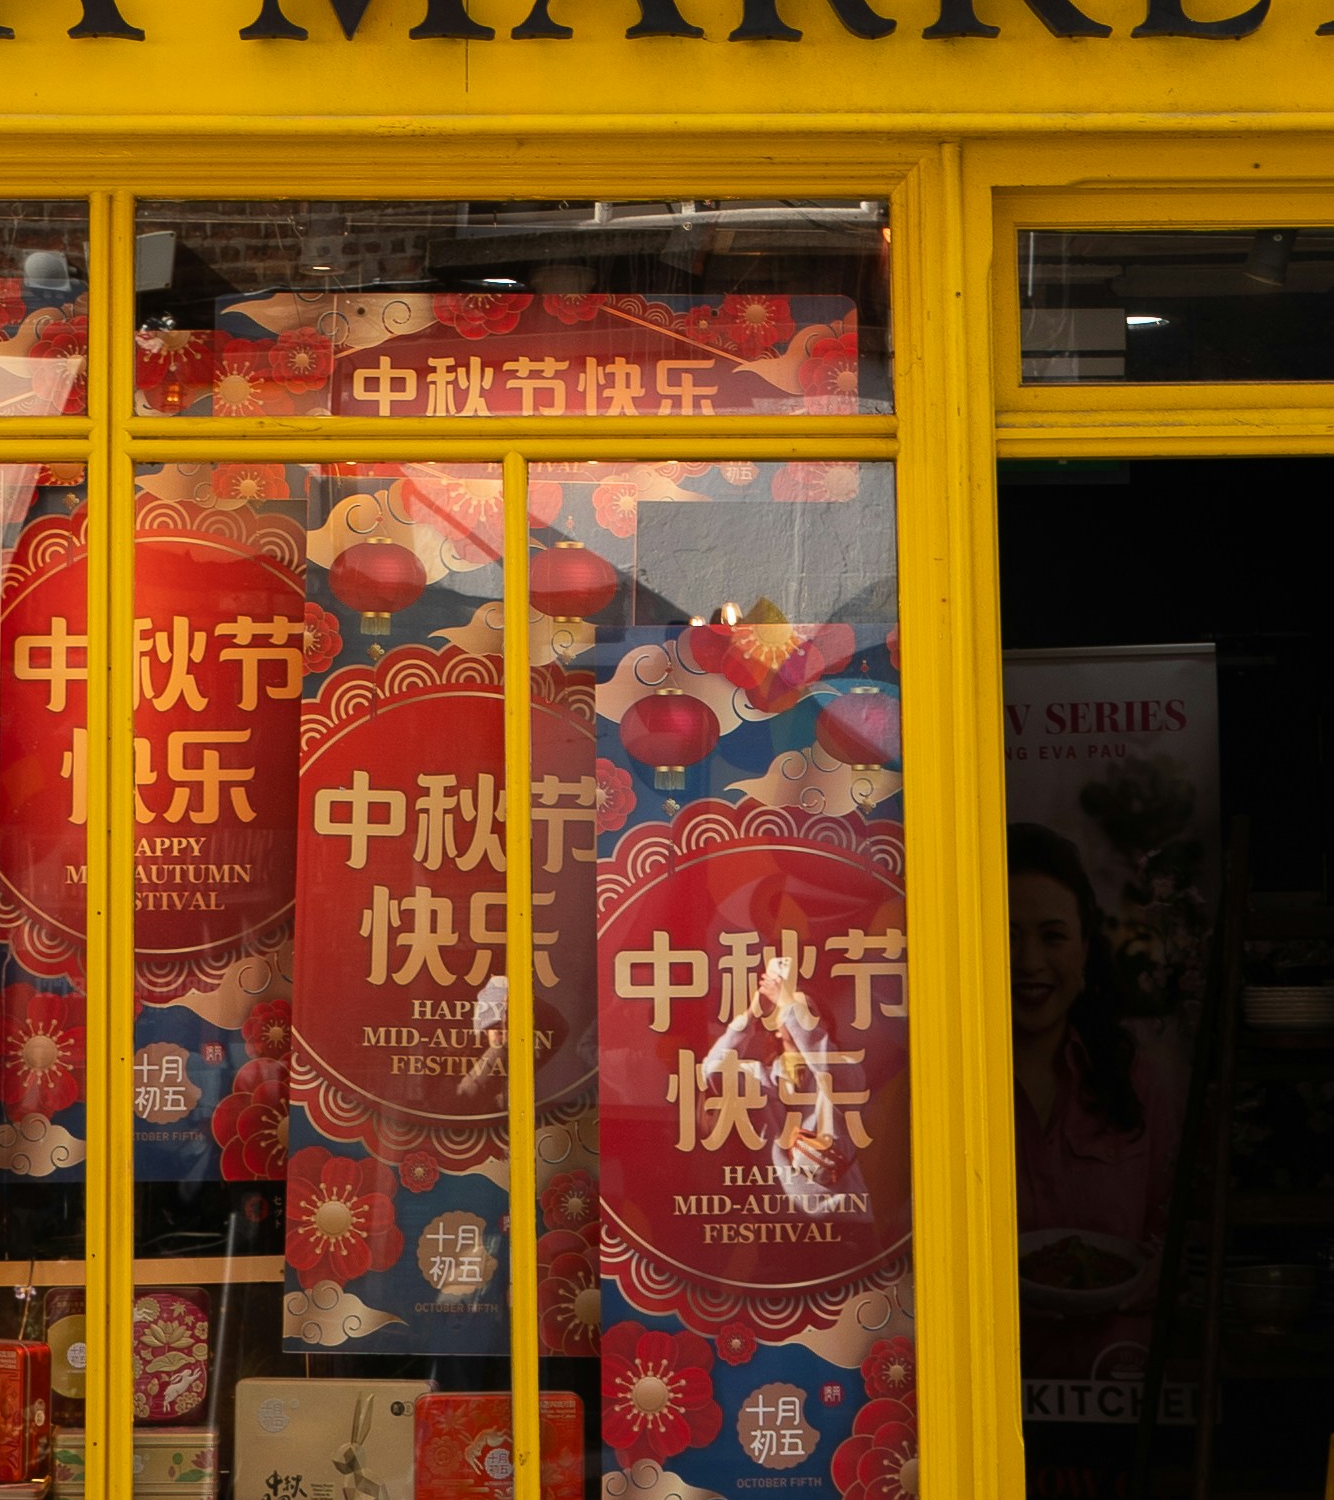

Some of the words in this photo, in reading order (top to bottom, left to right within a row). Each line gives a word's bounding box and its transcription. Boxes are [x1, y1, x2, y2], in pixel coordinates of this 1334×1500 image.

[352, 354, 720, 416] 中秋节快乐
[1045, 699, 1188, 736] SERIES
[1038, 746, 1077, 760] EVA
[1088, 744, 1126, 759] PAU
[135, 837, 207, 857] APPY
[64, 864, 252, 885] MAUTUMN
[135, 891, 225, 911] STIVAL
[614, 928, 909, 1033] 中秋节
[411, 1000, 507, 1020] HAPPY
[362, 1026, 554, 1050] MID-AUTUN
[133, 1053, 183, 1083] 十月
[391, 1055, 508, 1077] FESTIVA
[134, 1086, 187, 1119] 初五
[666, 1048, 874, 1152] 快乐
[133, 1131, 170, 1142] TOBER
[172, 1131, 204, 1142] FIFTH
[723, 1165, 820, 1187] HAPPY
[673, 1193, 869, 1216] MID-AUTUMN
[426, 1222, 479, 1253] 十月
[703, 1222, 841, 1244] FESTIVAL
[429, 1255, 483, 1290] 初五
[414, 1303, 464, 1313] OCTOBER
[746, 1394, 800, 1426] 十月
[750, 1429, 805, 1464] 初五
[736, 1478, 787, 1488] OCTOBER
[790, 1477, 823, 1487] FIFTH
